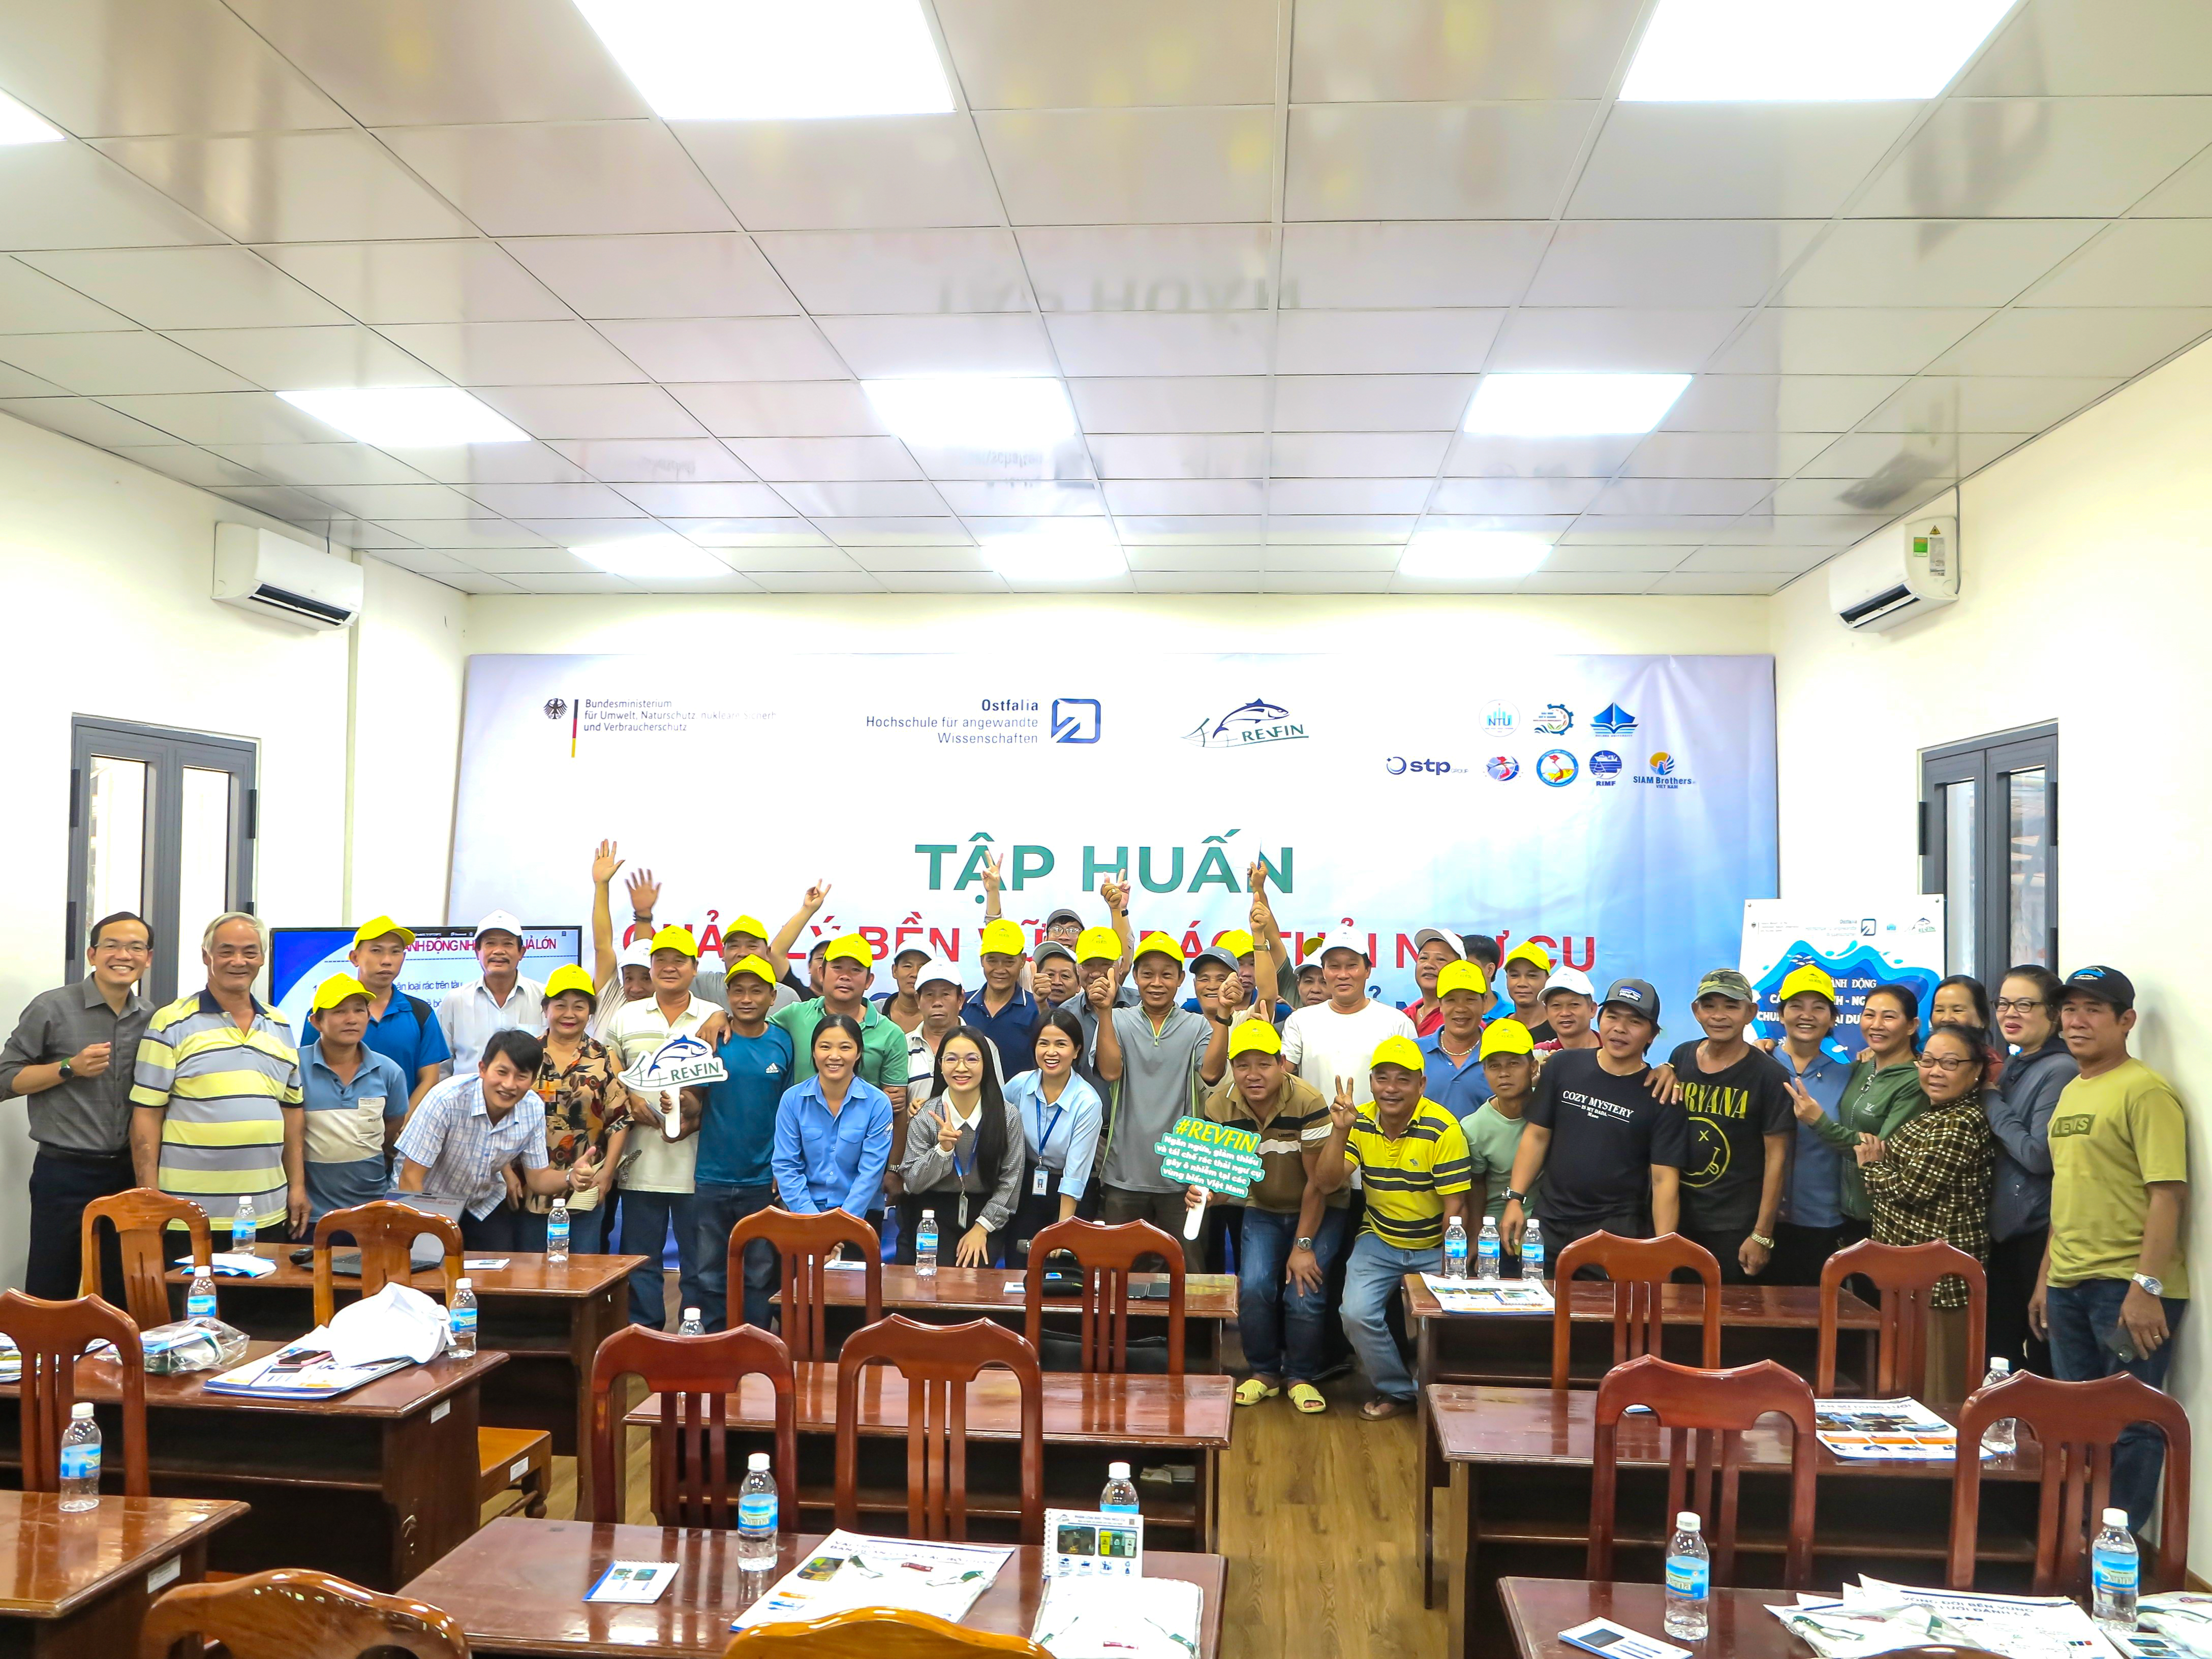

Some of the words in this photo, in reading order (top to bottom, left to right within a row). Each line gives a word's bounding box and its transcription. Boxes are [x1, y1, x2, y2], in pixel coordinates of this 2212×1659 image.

[585, 698, 672, 708] Bundesministerium
[981, 699, 1038, 712] Ostfalia
[585, 711, 598, 720] für
[600, 711, 638, 721] Umwelt,
[1489, 718, 1510, 726] NTU
[584, 723, 601, 731] und
[604, 723, 687, 732] Verbraucherschutz
[866, 716, 938, 728] Hochschule
[941, 716, 959, 728] für
[962, 716, 1038, 731] angewandte
[937, 732, 1038, 744] Wissenschaften
[1410, 759, 1451, 775] stp
[1633, 776, 1654, 784] SIAM
[1656, 776, 1692, 784] Brothers
[915, 832, 1055, 904] TẬP
[1082, 829, 1293, 894] HUẤN
[426, 937, 458, 954] ĐỘNG
[422, 980, 435, 990] rác
[436, 980, 449, 990] trên
[1852, 977, 1877, 990] ĐỘNG
[671, 1062, 720, 1081] REVFIN
[1563, 1090, 1589, 1103] COZY
[1588, 1097, 1635, 1118] MYSTERY
[1176, 1119, 1258, 1152] #REVFIN
[1199, 1155, 1213, 1165] rác
[1231, 1174, 1247, 1185] các
[1206, 1178, 1224, 1190] Việt
[1225, 1183, 1245, 1195] Nam
